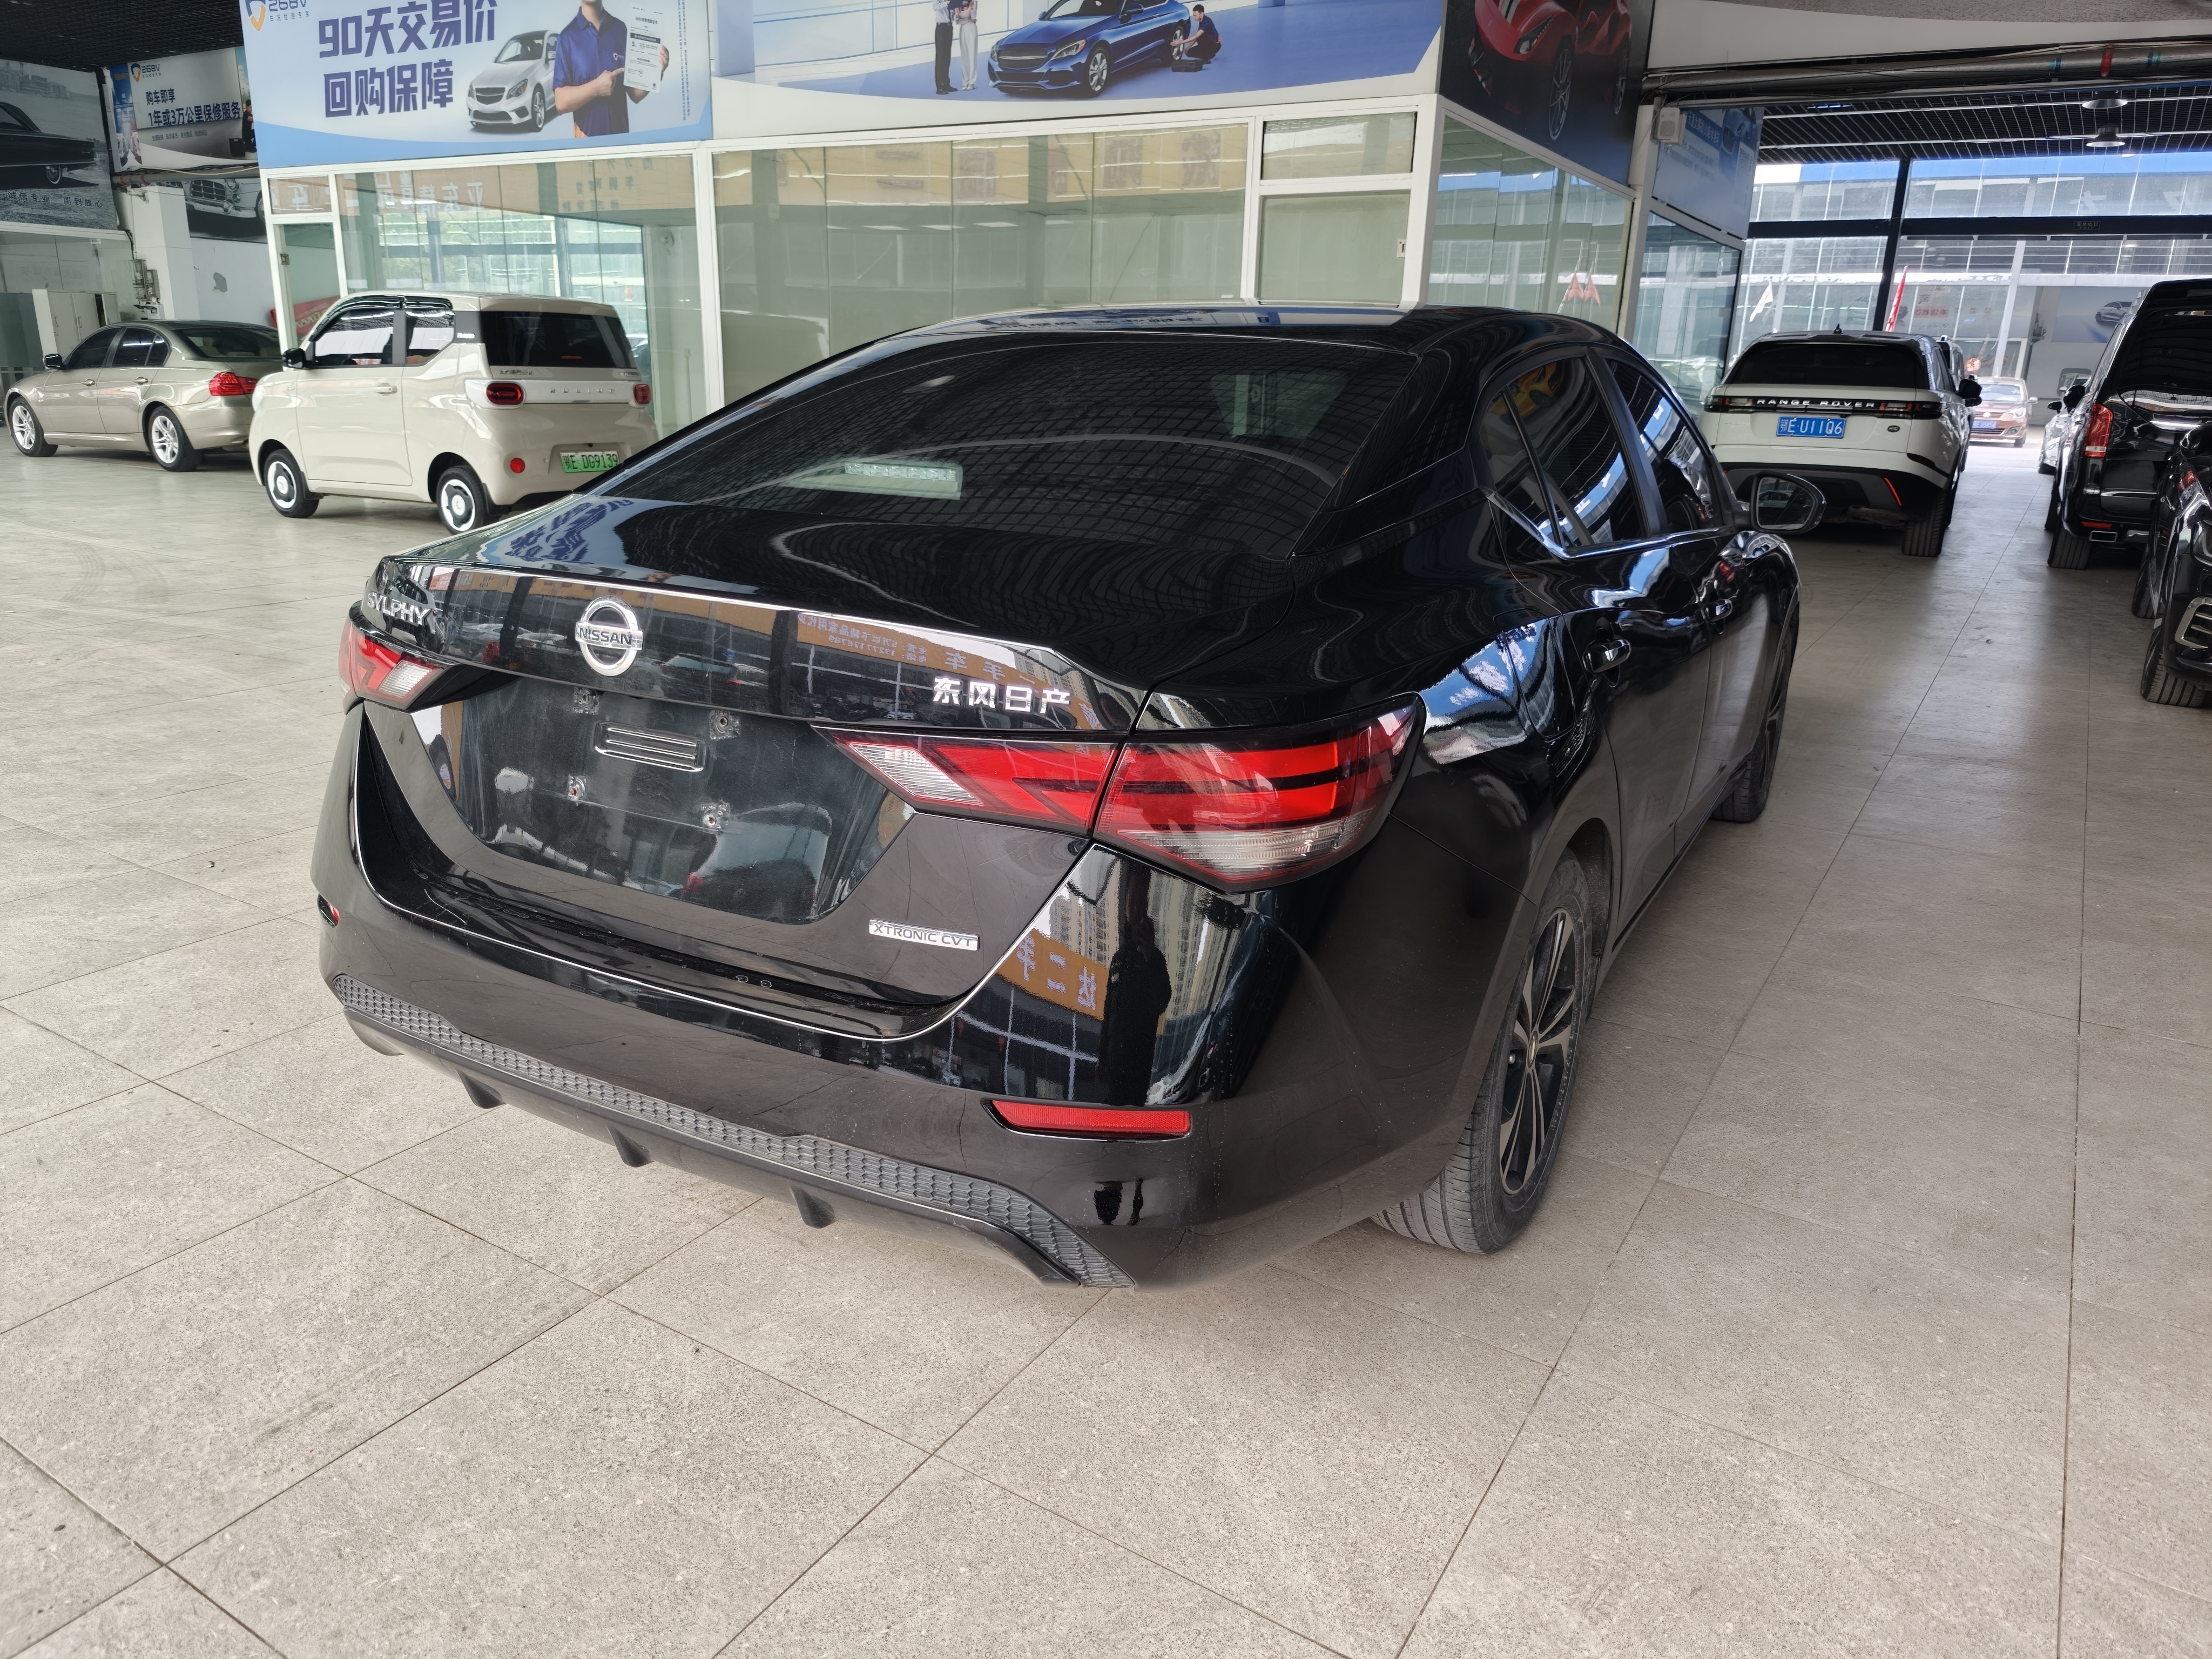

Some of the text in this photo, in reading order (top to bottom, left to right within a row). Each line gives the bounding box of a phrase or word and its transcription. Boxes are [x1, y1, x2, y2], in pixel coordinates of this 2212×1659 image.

[319, 0, 498, 58] 90天交易价
[146, 89, 176, 106] 购车即享
[324, 59, 454, 118] 回购保障
[148, 102, 240, 127] 1年或3万公里保修服务
[8, 191, 103, 208] 诚信专业 周到放心
[367, 592, 433, 625] SYLPHY
[579, 626, 632, 645] NISSAN
[932, 677, 1070, 714] 东风日产
[874, 923, 973, 948] XTRONIC CVT
